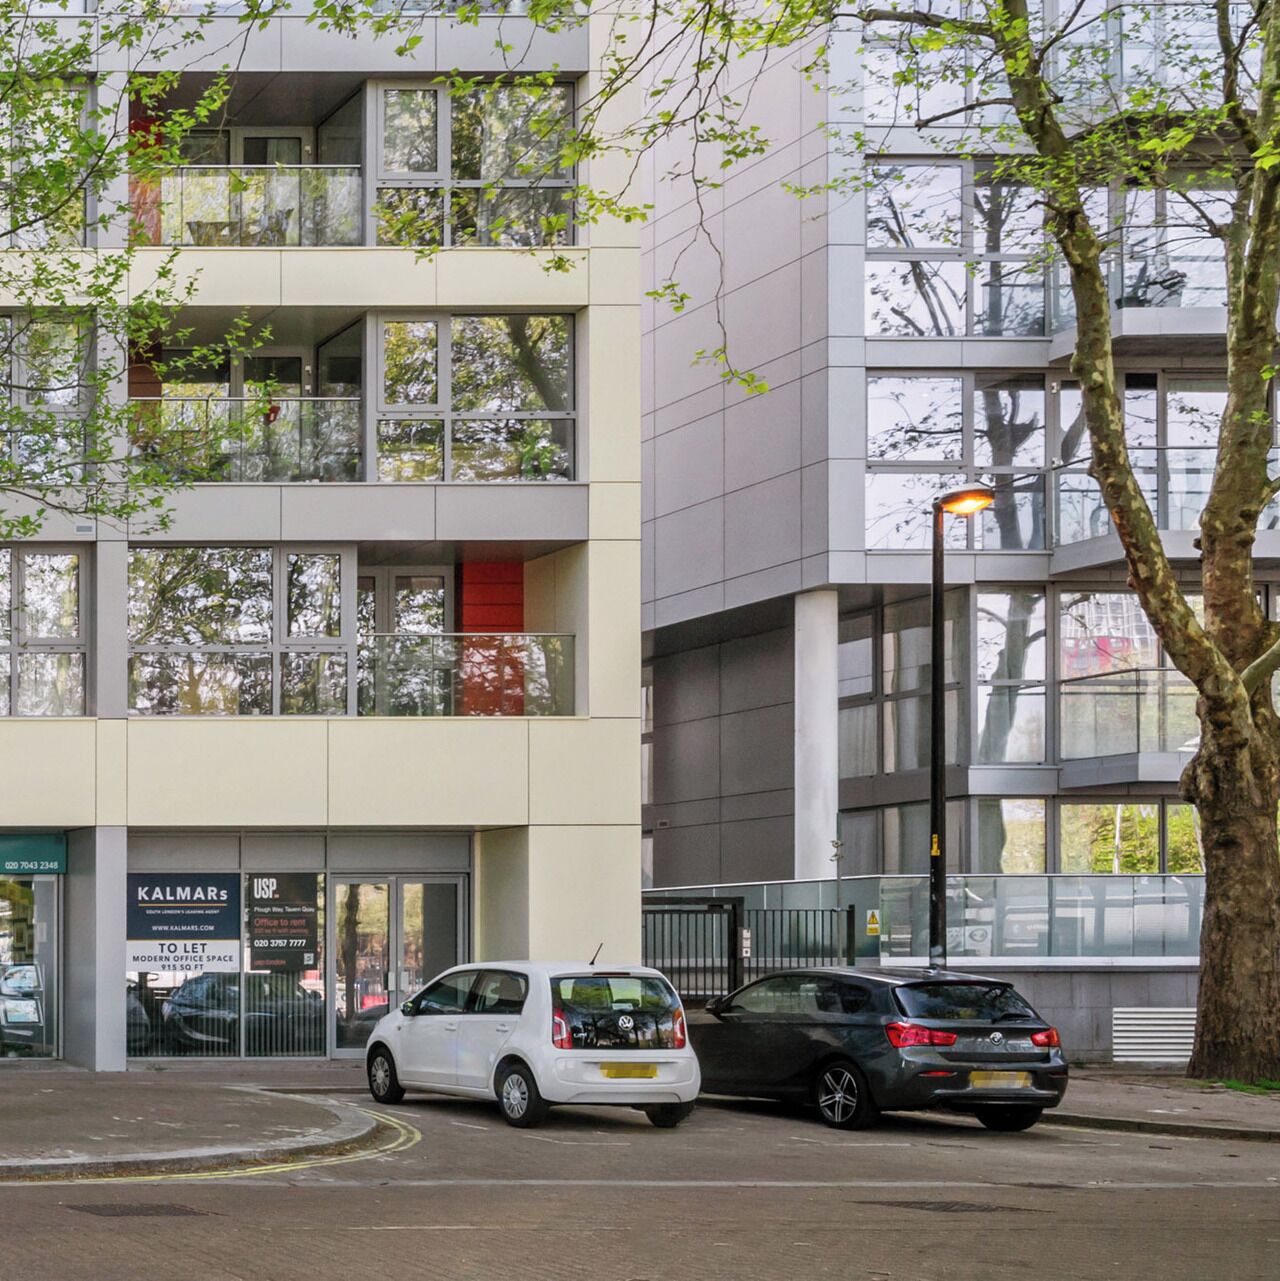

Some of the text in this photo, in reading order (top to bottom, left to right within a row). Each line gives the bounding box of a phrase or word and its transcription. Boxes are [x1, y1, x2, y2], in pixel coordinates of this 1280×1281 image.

[4, 861, 59, 870] 020 7043 2348
[254, 918, 306, 927] Office to rent
[254, 939, 307, 948] 020 3757 7777
[158, 943, 208, 954] TO LET
